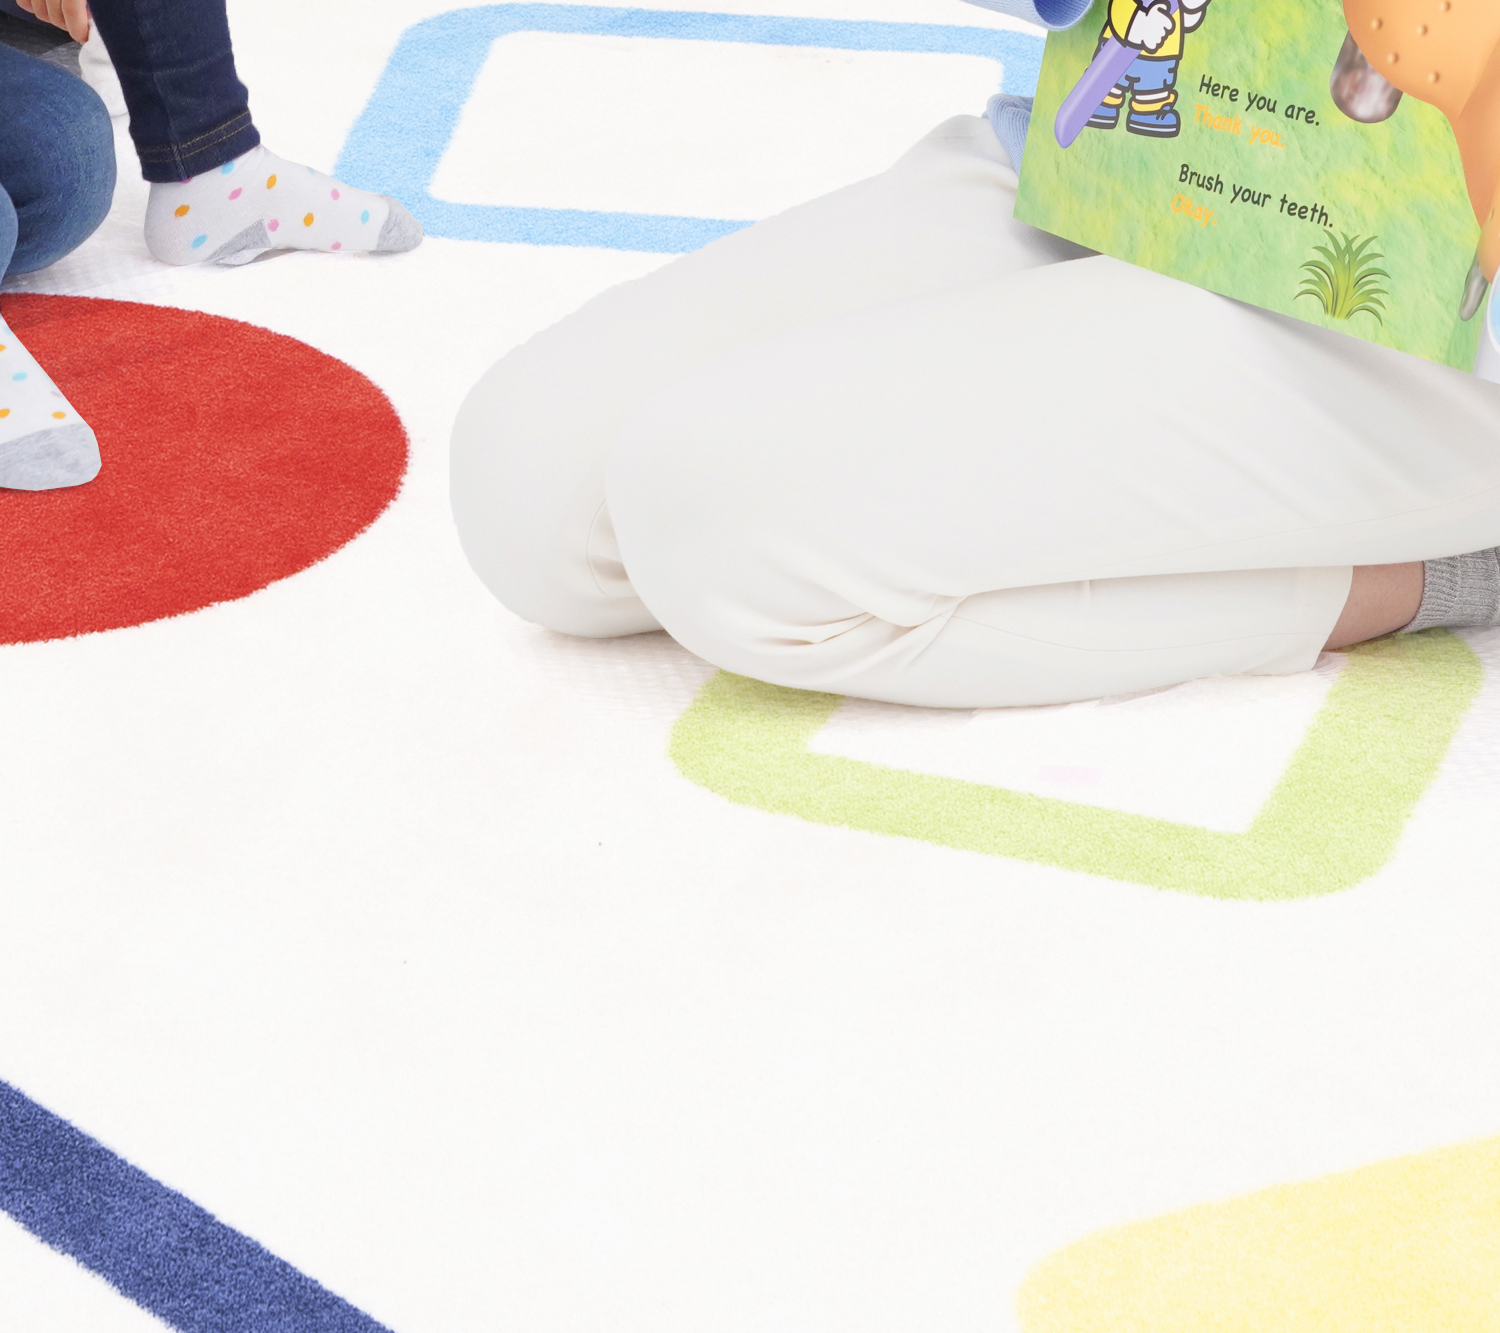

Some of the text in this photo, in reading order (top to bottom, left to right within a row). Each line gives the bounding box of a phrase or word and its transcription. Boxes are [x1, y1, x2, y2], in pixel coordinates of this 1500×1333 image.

[1199, 73, 1321, 127] Here you are.
[1193, 103, 1286, 149] Thank you.
[1170, 193, 1218, 228] Okay.
[1178, 163, 1334, 229] Brush your teeth.
